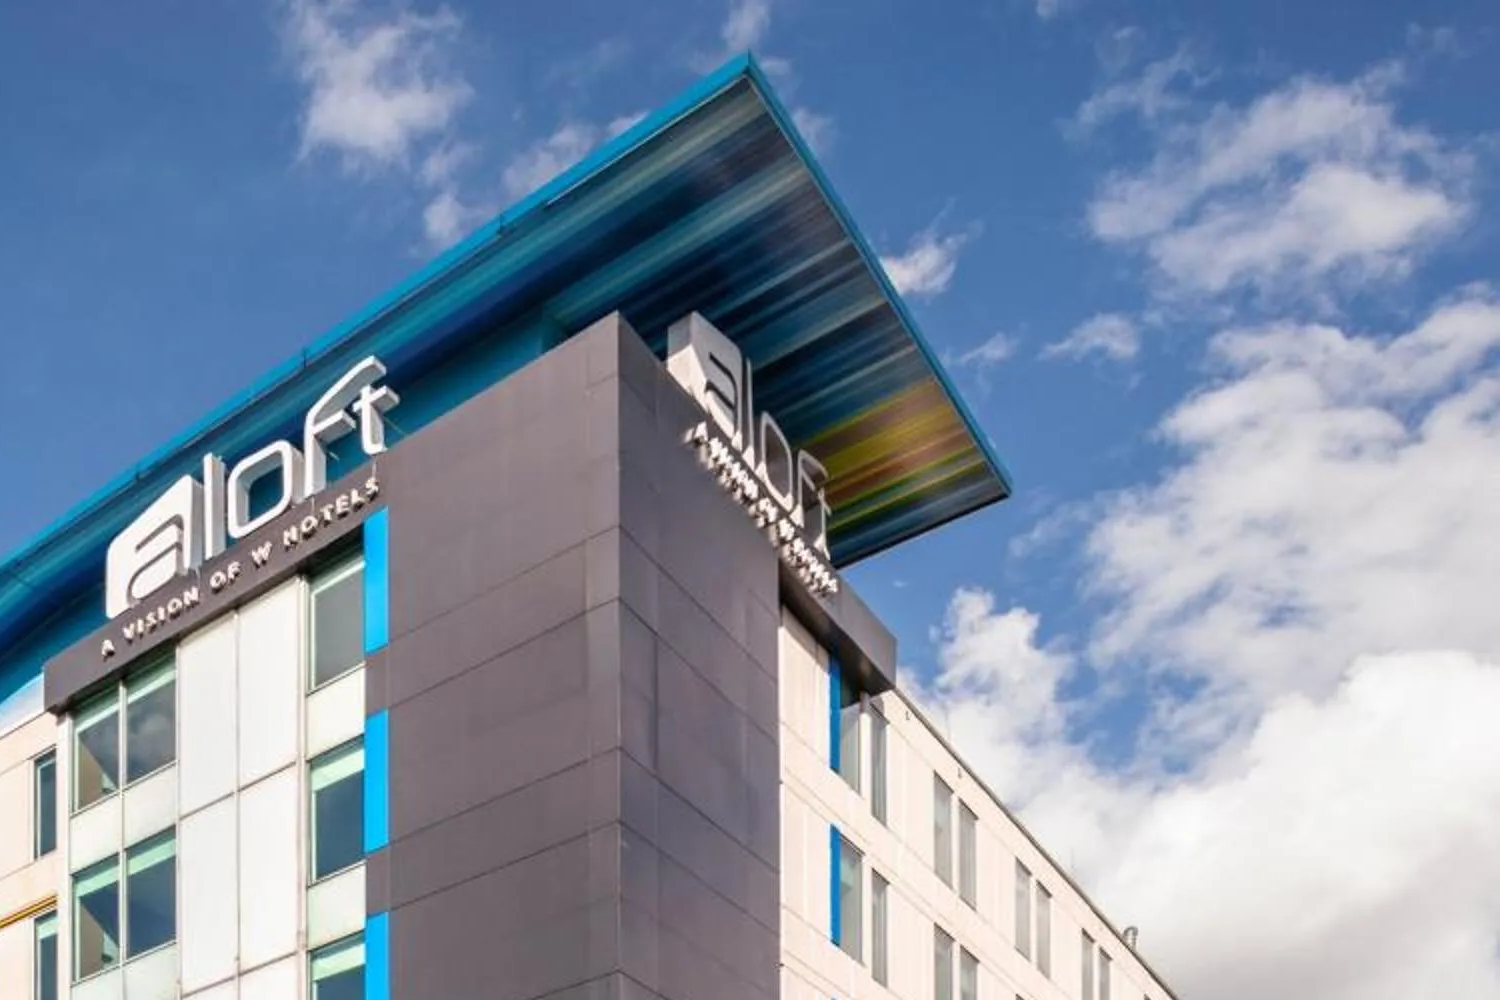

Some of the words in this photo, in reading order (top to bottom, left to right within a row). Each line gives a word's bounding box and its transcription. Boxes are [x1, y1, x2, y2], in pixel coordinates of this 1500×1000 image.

[100, 639, 116, 658] A
[122, 586, 200, 641] VISION
[209, 560, 242, 591] OF
[251, 541, 273, 568] W
[283, 476, 380, 550] HOTELS
[105, 354, 400, 619] aloft
